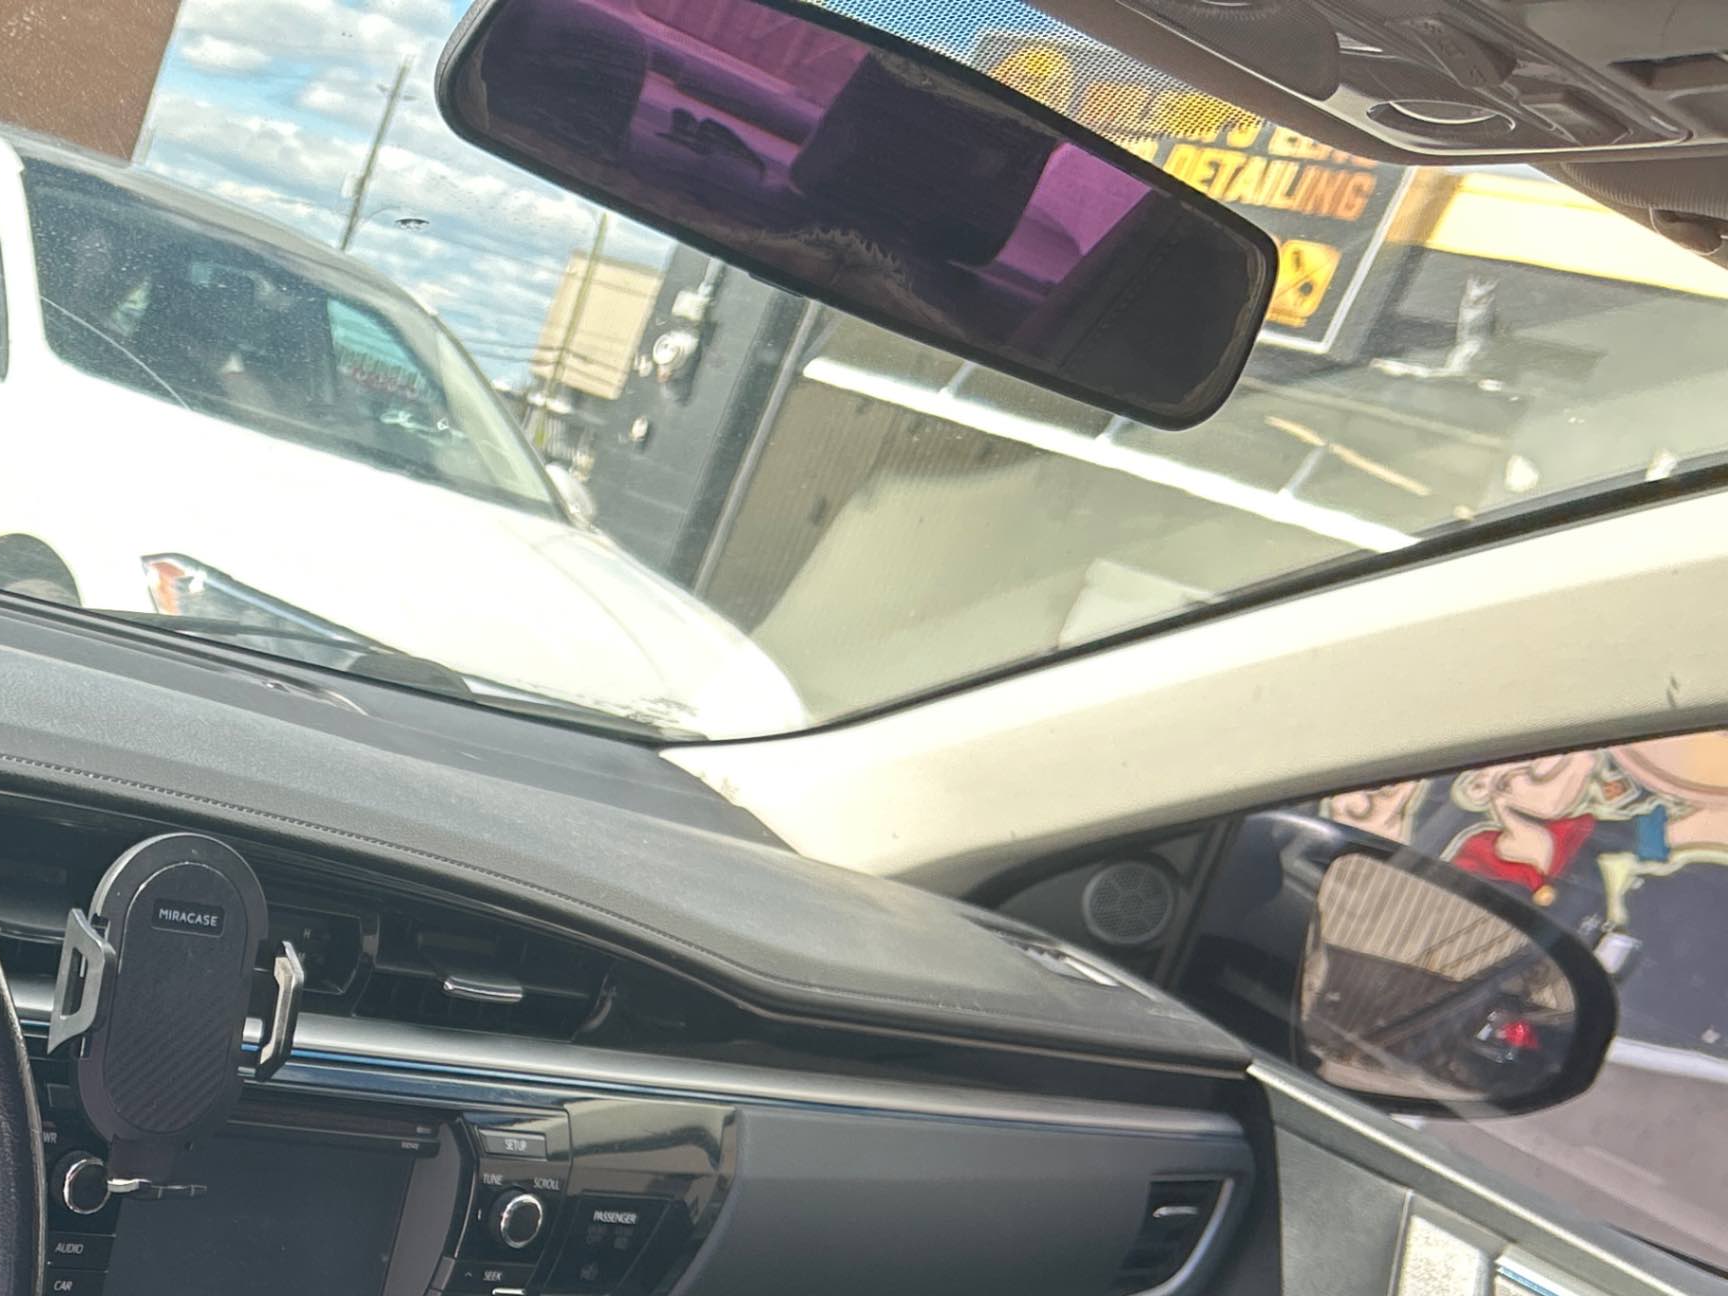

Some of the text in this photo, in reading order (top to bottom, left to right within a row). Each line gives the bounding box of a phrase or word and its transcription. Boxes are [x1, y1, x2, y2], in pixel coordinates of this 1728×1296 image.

[1162, 143, 1376, 222] DETAILING
[158, 908, 219, 927] MIRACASE
[42, 1132, 58, 1144] WR
[504, 1139, 528, 1151] SETUP
[483, 1174, 503, 1186] TUNE
[533, 1178, 560, 1191] SCROLL
[593, 1210, 637, 1225] PASSENGER
[55, 1243, 84, 1254] AUDIO
[483, 1271, 502, 1281] SEEK
[53, 1280, 73, 1291] CAR
